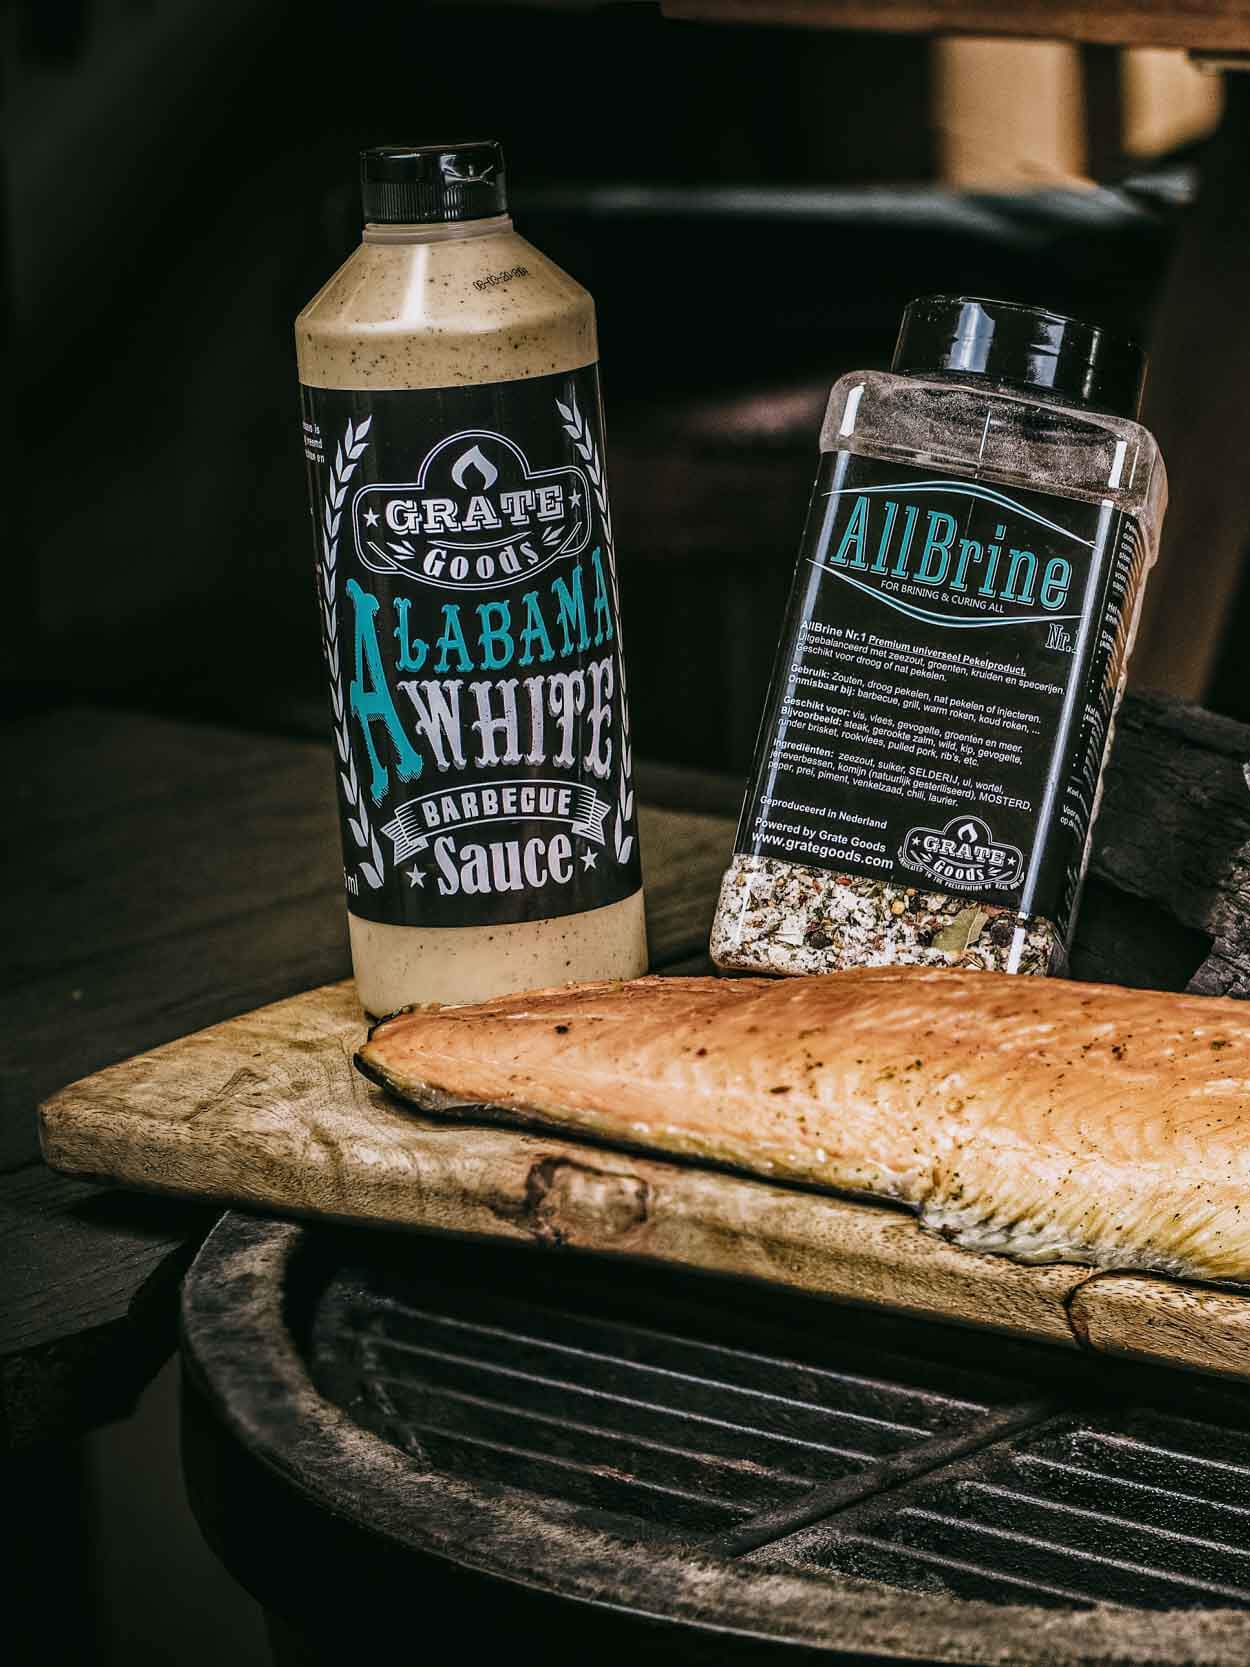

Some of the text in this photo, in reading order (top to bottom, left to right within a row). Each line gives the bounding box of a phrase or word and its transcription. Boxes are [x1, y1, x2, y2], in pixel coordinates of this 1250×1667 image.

[385, 485, 564, 534] GRATE
[423, 540, 539, 580] Goods
[830, 496, 1073, 611] AllBrine
[880, 579, 1005, 615] FOR BRINING & CURING ALL
[795, 641, 947, 682] Geschikt voor droog of nat pekelen.
[799, 619, 843, 637] AllBrine
[845, 629, 866, 642] Nr.1
[867, 634, 910, 653] Premium
[911, 646, 961, 663] universeel
[346, 547, 614, 807] ALABAMA
[790, 662, 1041, 724] Gebruik: Zouten, droog pekelen, nat pekelen of injecteren.
[869, 648, 887, 658] met
[888, 652, 925, 667] zeezout,
[927, 660, 968, 676] groenten,
[970, 667, 1003, 682] kruiden
[1005, 676, 1017, 685] en
[1018, 679, 1065, 695] specerijen.
[397, 655, 615, 780] WHITE
[783, 695, 1023, 753] Geschikt voor: vis, vlees, gevogelte, groenten en meer.
[788, 673, 839, 691] Onmisbaar
[839, 684, 855, 696] bij:
[857, 688, 900, 706] barbecue,
[902, 700, 920, 711] grill,
[923, 703, 948, 715] warm
[949, 709, 976, 722] roken,
[978, 713, 1001, 726] koud
[1002, 720, 1029, 733] roken,
[780, 705, 1022, 765] Bijvoorbeeld: steak, gerookte zalm, wild, kip, gevogelte,
[807, 722, 839, 737] brisket,
[841, 731, 885, 748] rookvlees,
[887, 741, 915, 753] pulled
[915, 747, 938, 759] pork,
[963, 756, 979, 766] etc.
[773, 737, 834, 758] Ingrediënten:
[838, 752, 875, 768] zeezout,
[877, 761, 906, 774] suiker,
[908, 766, 960, 786] SELDERIJ,
[421, 785, 573, 828] BARBECUE
[796, 766, 815, 777] prei,
[817, 770, 849, 784] piment,
[852, 778, 904, 797] venkelzaad,
[906, 788, 926, 801] chili,
[928, 792, 958, 807] laurier.
[837, 761, 867, 777] komijn
[868, 768, 911, 787] (natuurlijk
[978, 791, 1032, 812] MOSTERD,
[760, 794, 887, 829] Geproduceerd in Nederland
[751, 832, 894, 870] www.grategoods.com
[754, 816, 886, 853] Powered by Grate Goods
[922, 835, 1006, 866] GRATE
[433, 833, 575, 895] Sauce
[932, 859, 985, 881] Goods
